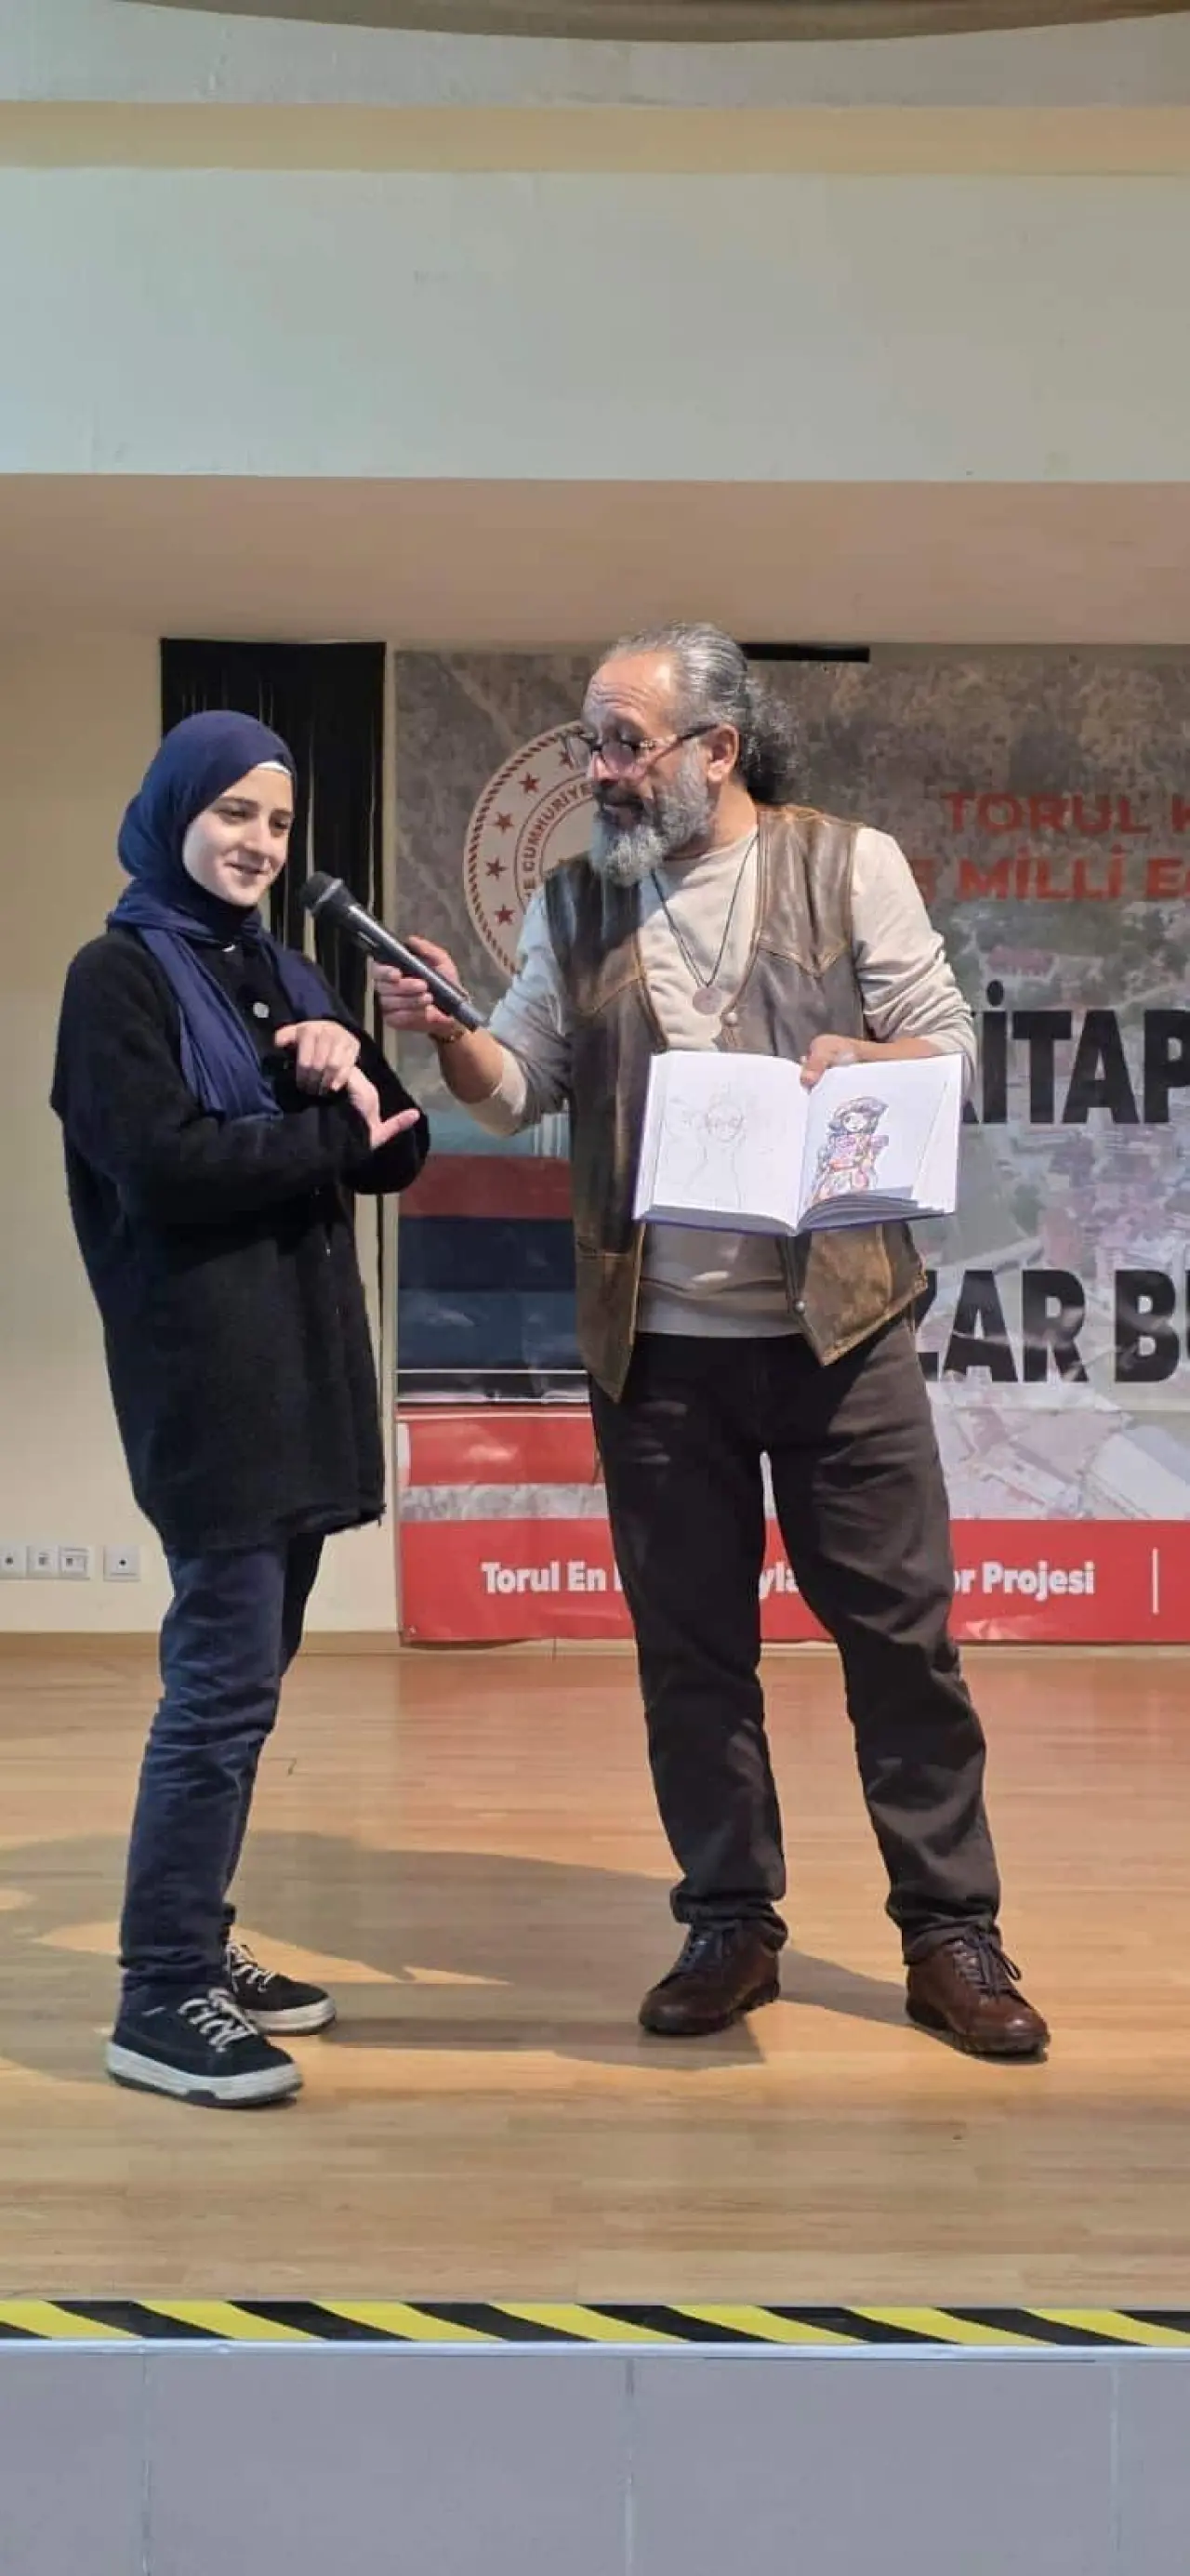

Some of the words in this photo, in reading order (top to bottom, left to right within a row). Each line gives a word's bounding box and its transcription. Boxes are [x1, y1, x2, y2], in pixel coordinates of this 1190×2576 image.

[943, 793, 1152, 835] TORUL
[958, 843, 1124, 902] MİLLİ
[1146, 857, 1190, 900] E
[961, 980, 1190, 1124] İTAP
[1115, 1269, 1190, 1382] B
[482, 1561, 560, 1593] Torul
[567, 1562, 606, 1592] En
[983, 1561, 1094, 1601] Projesi
